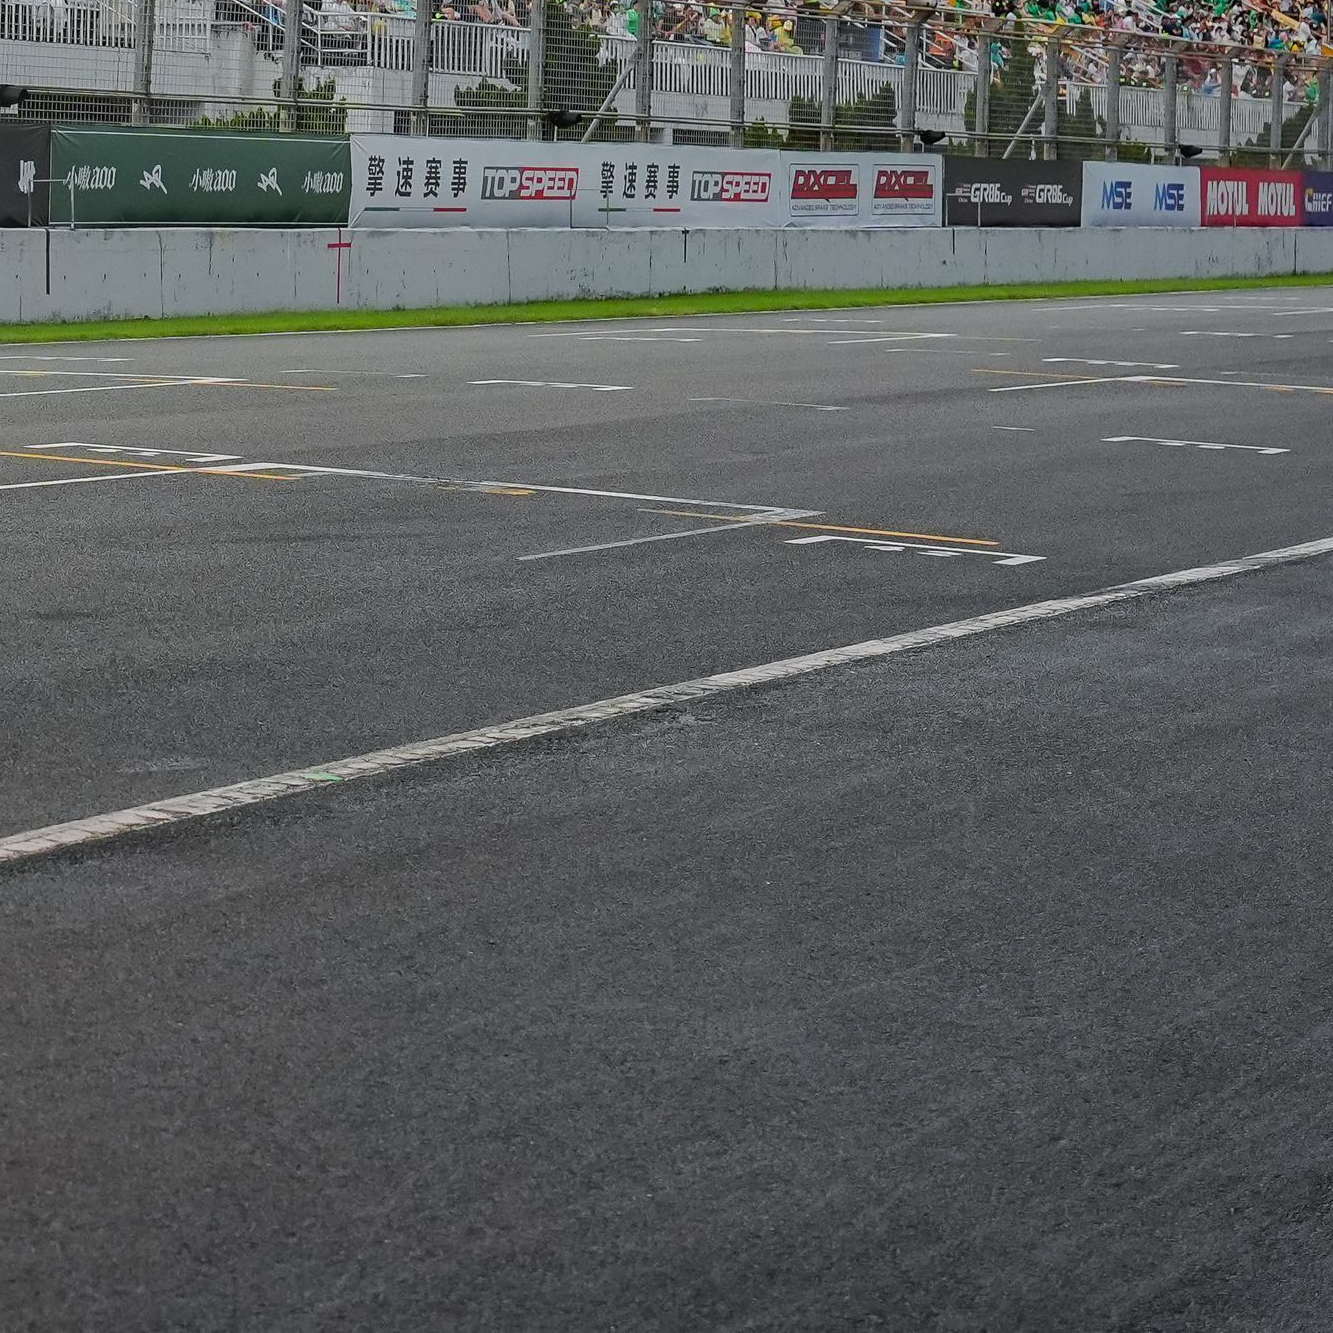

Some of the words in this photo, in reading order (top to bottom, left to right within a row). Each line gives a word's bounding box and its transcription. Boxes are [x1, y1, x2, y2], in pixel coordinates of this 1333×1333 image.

[365, 156, 468, 199] 擎速赛事
[600, 162, 681, 201] 擎速赛事
[971, 183, 1000, 202] GR86
[1001, 192, 1012, 206] Cup
[1035, 184, 1062, 203] GR86
[1063, 193, 1073, 206] Cup
[1101, 180, 1132, 210] MSE
[1154, 182, 1184, 211] MSE
[1206, 180, 1249, 216] MOTUL
[1257, 181, 1295, 217] MOTUL
